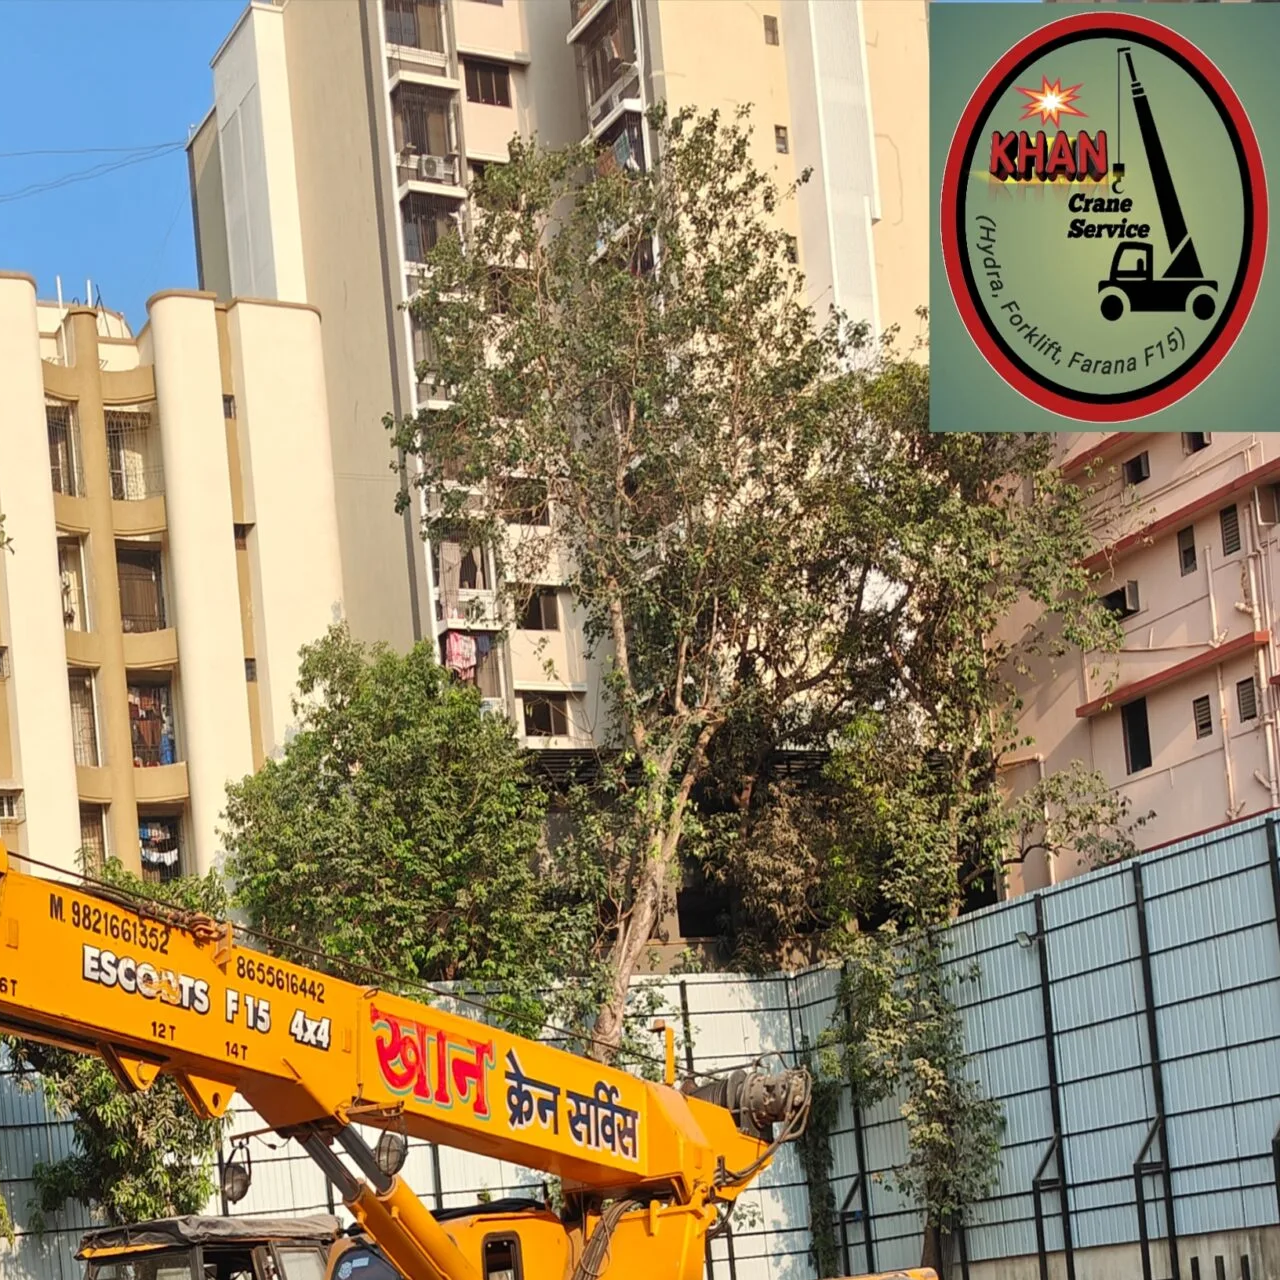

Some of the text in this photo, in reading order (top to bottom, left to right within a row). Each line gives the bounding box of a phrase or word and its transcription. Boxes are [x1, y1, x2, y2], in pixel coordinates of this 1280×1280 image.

[71, 900, 170, 955] 9821661352
[236, 956, 325, 1004] 8655616442
[370, 1002, 640, 1160] खान क्रेन सर्विस
